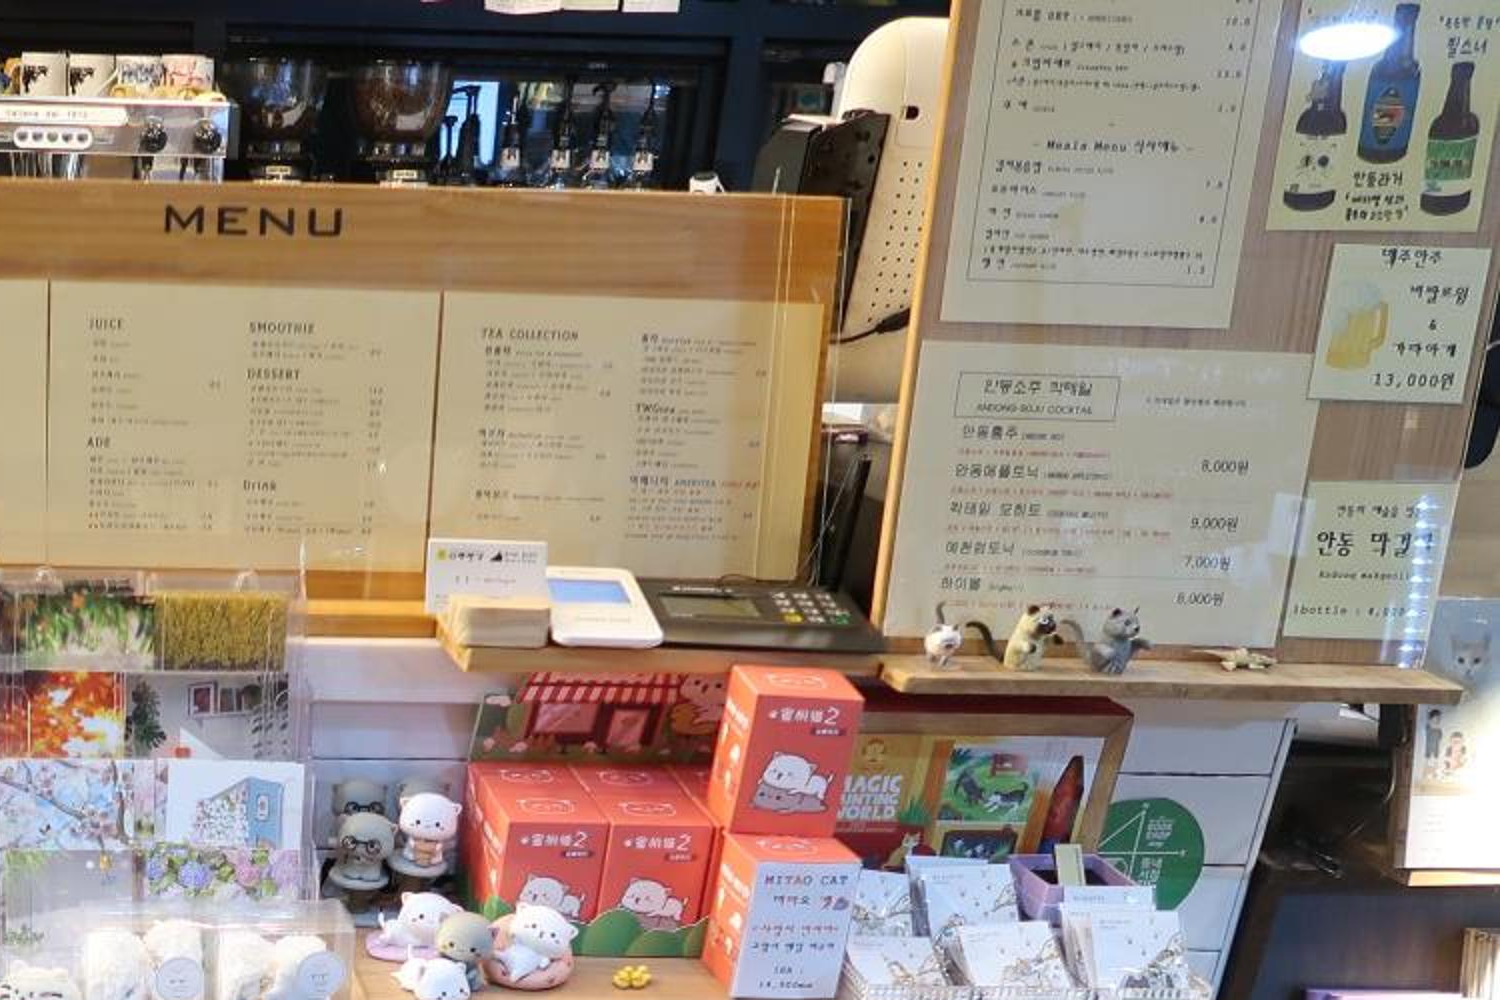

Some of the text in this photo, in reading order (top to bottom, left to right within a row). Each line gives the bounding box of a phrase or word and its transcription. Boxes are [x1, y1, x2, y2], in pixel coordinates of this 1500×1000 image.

[1047, 140, 1087, 151] Meals
[1093, 140, 1127, 152] Menu
[165, 205, 343, 238] MENU
[89, 318, 124, 331] JUICE
[249, 321, 316, 335] SMOOTHIE
[481, 328, 579, 341] TEA COLLECTION
[246, 367, 301, 381] DESSERT
[983, 379, 1042, 397] 안동소주
[1373, 372, 1455, 391] 13,000원
[1047, 405, 1093, 416] COCKTAIL
[86, 436, 112, 449] ADE
[243, 479, 278, 492] Drink
[1316, 530, 1355, 558] 안동
[821, 875, 849, 885] CAT
